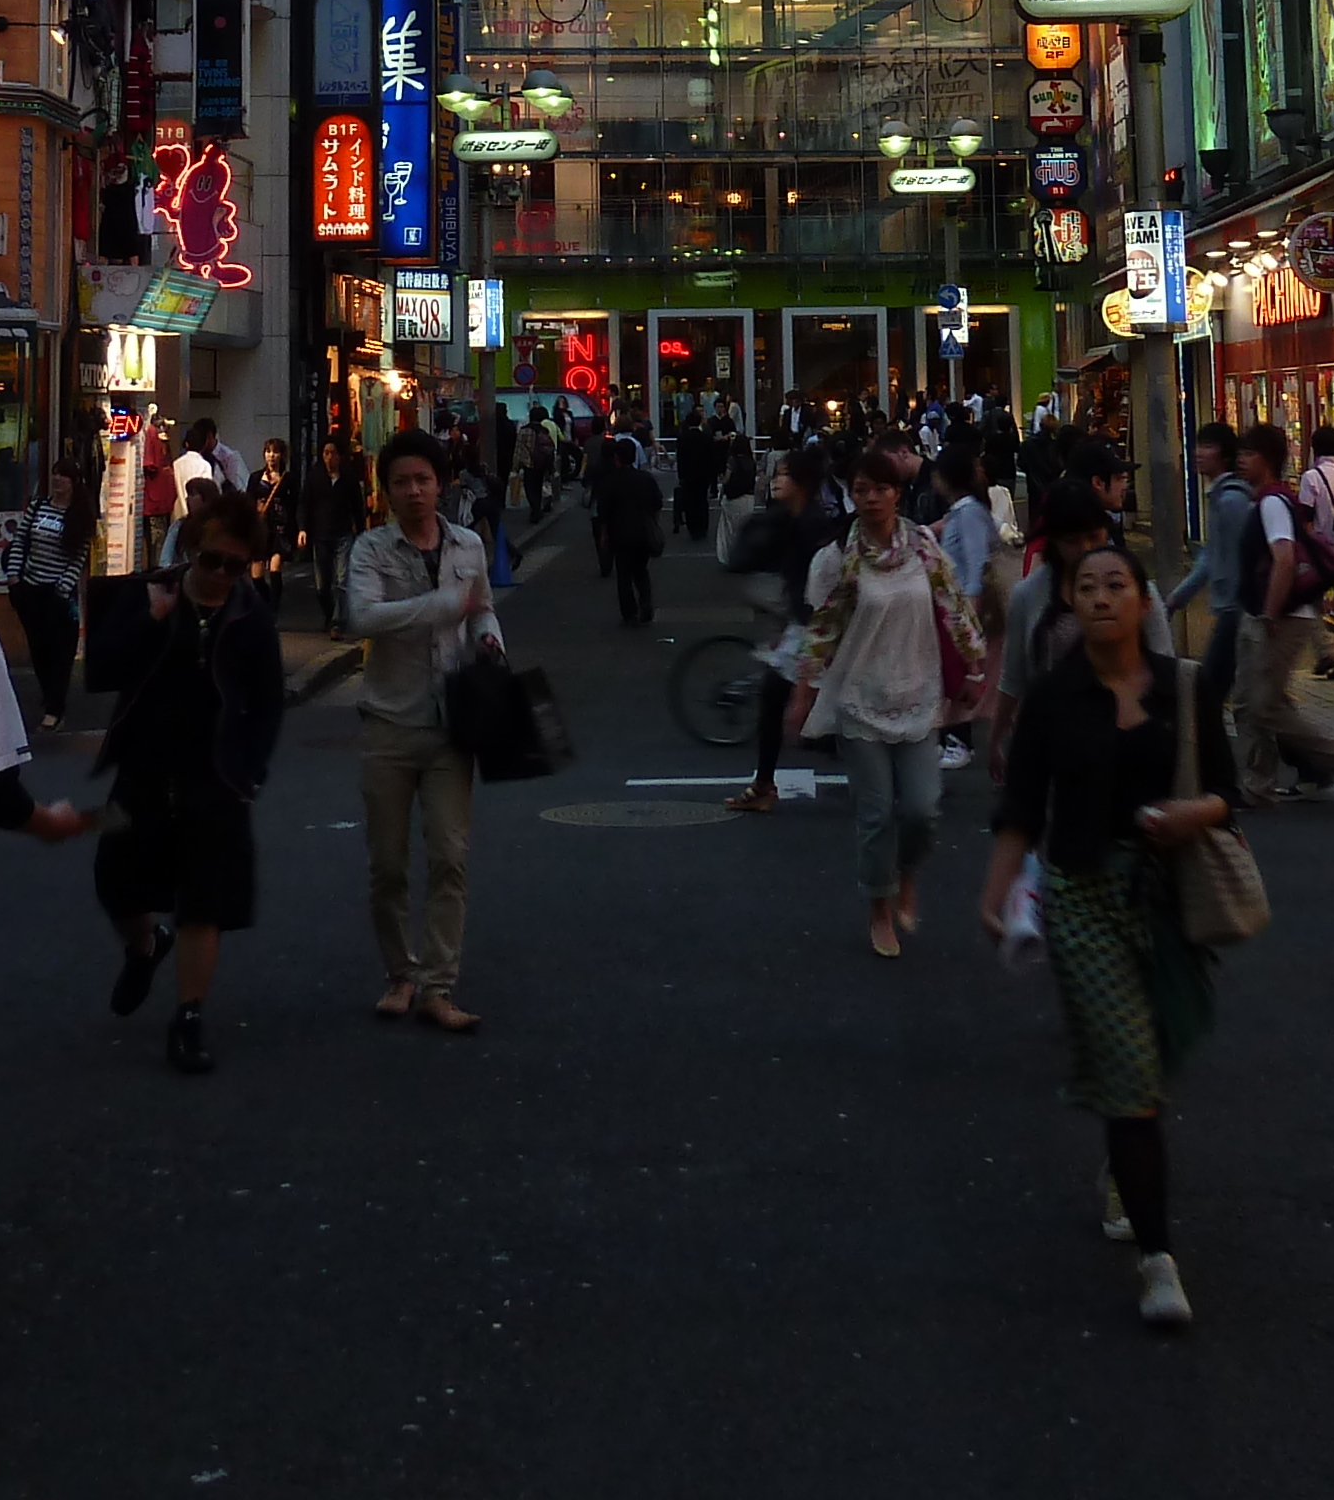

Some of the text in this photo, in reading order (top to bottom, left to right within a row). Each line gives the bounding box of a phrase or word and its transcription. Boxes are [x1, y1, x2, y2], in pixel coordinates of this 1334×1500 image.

[1045, 50, 1065, 59] 2F
[318, 79, 368, 93] レンタルスペース
[327, 123, 358, 137] B1F
[459, 138, 553, 152] 渋谷センター街
[320, 138, 341, 221] サムラート
[348, 136, 367, 221] インド料理
[1034, 159, 1081, 187] HUB
[444, 196, 458, 263] SHIBUYA
[1149, 215, 1158, 229] A
[395, 270, 450, 289] 新幹線回数券
[396, 296, 418, 317] MAX
[397, 318, 419, 339] 買取
[109, 415, 140, 433] EN
